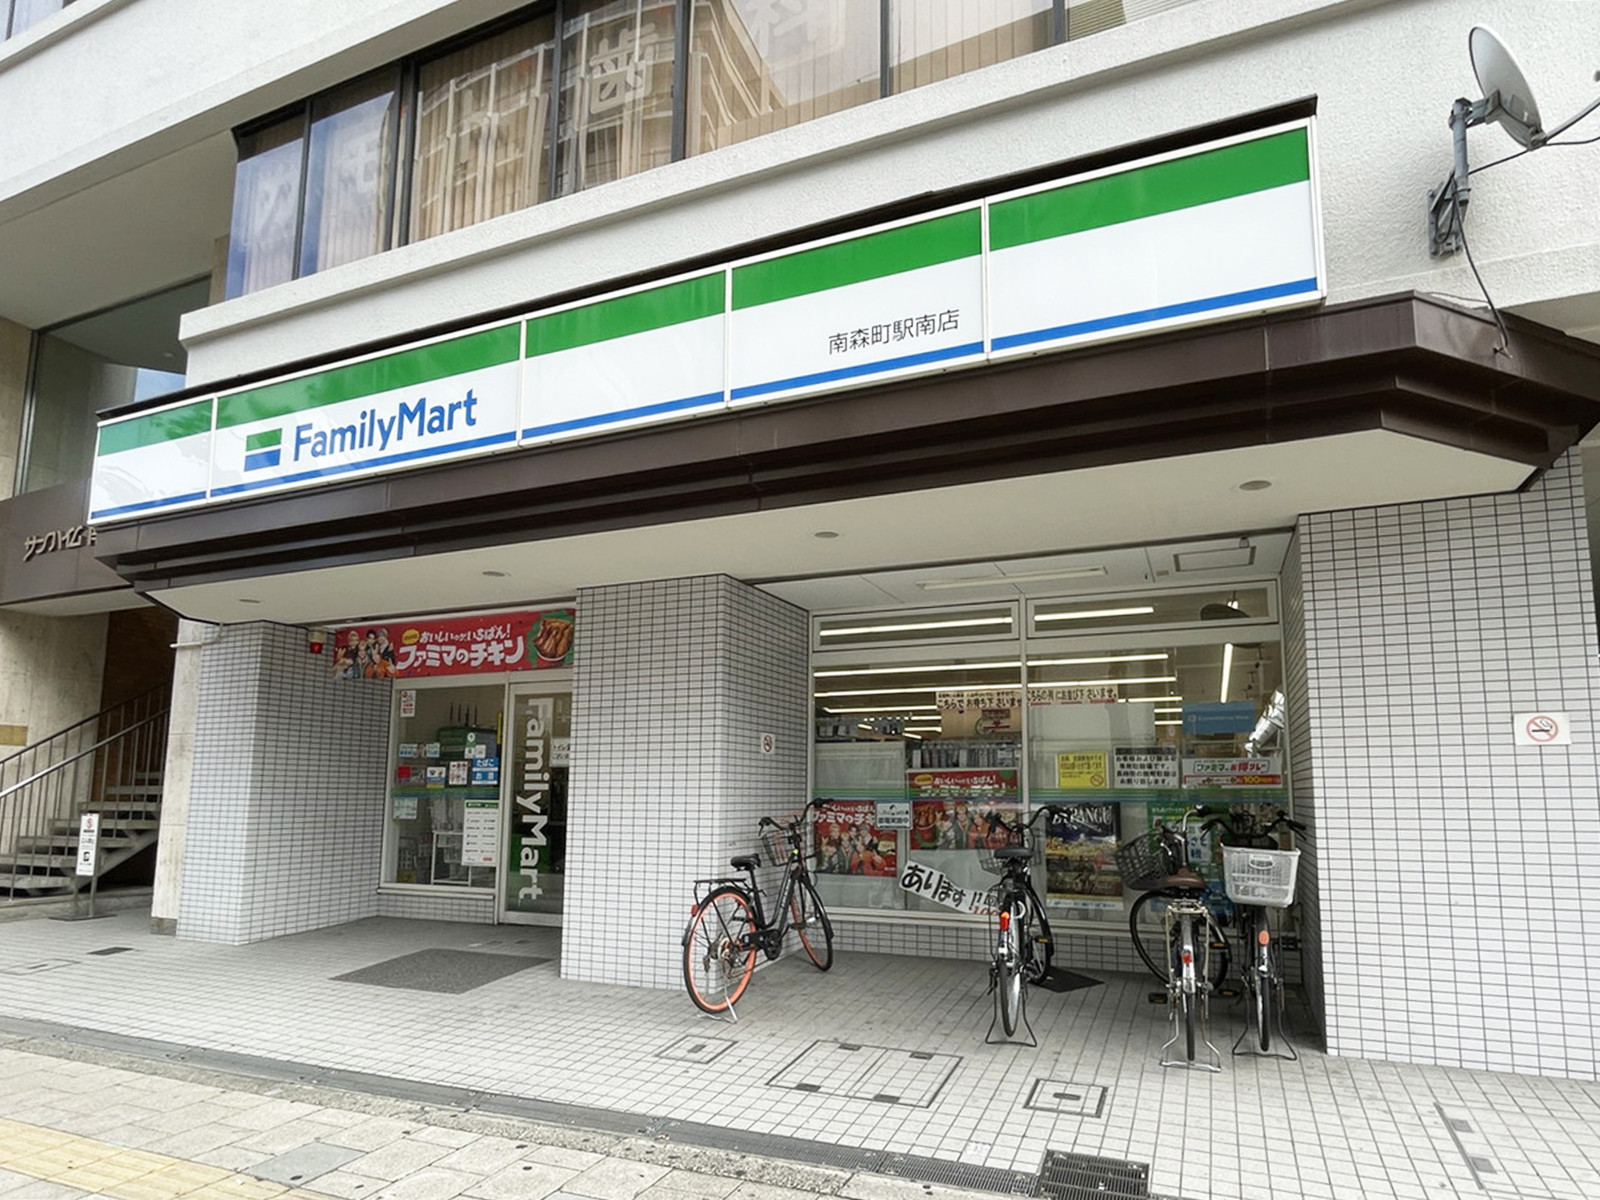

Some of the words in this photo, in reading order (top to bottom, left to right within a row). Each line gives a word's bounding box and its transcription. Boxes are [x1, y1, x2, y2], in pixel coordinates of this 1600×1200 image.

[828, 309, 960, 355] 南森町駅南店
[294, 389, 477, 461] FamilyMart
[397, 636, 524, 670] ファミマのチキン
[516, 697, 554, 900] FamilyMart
